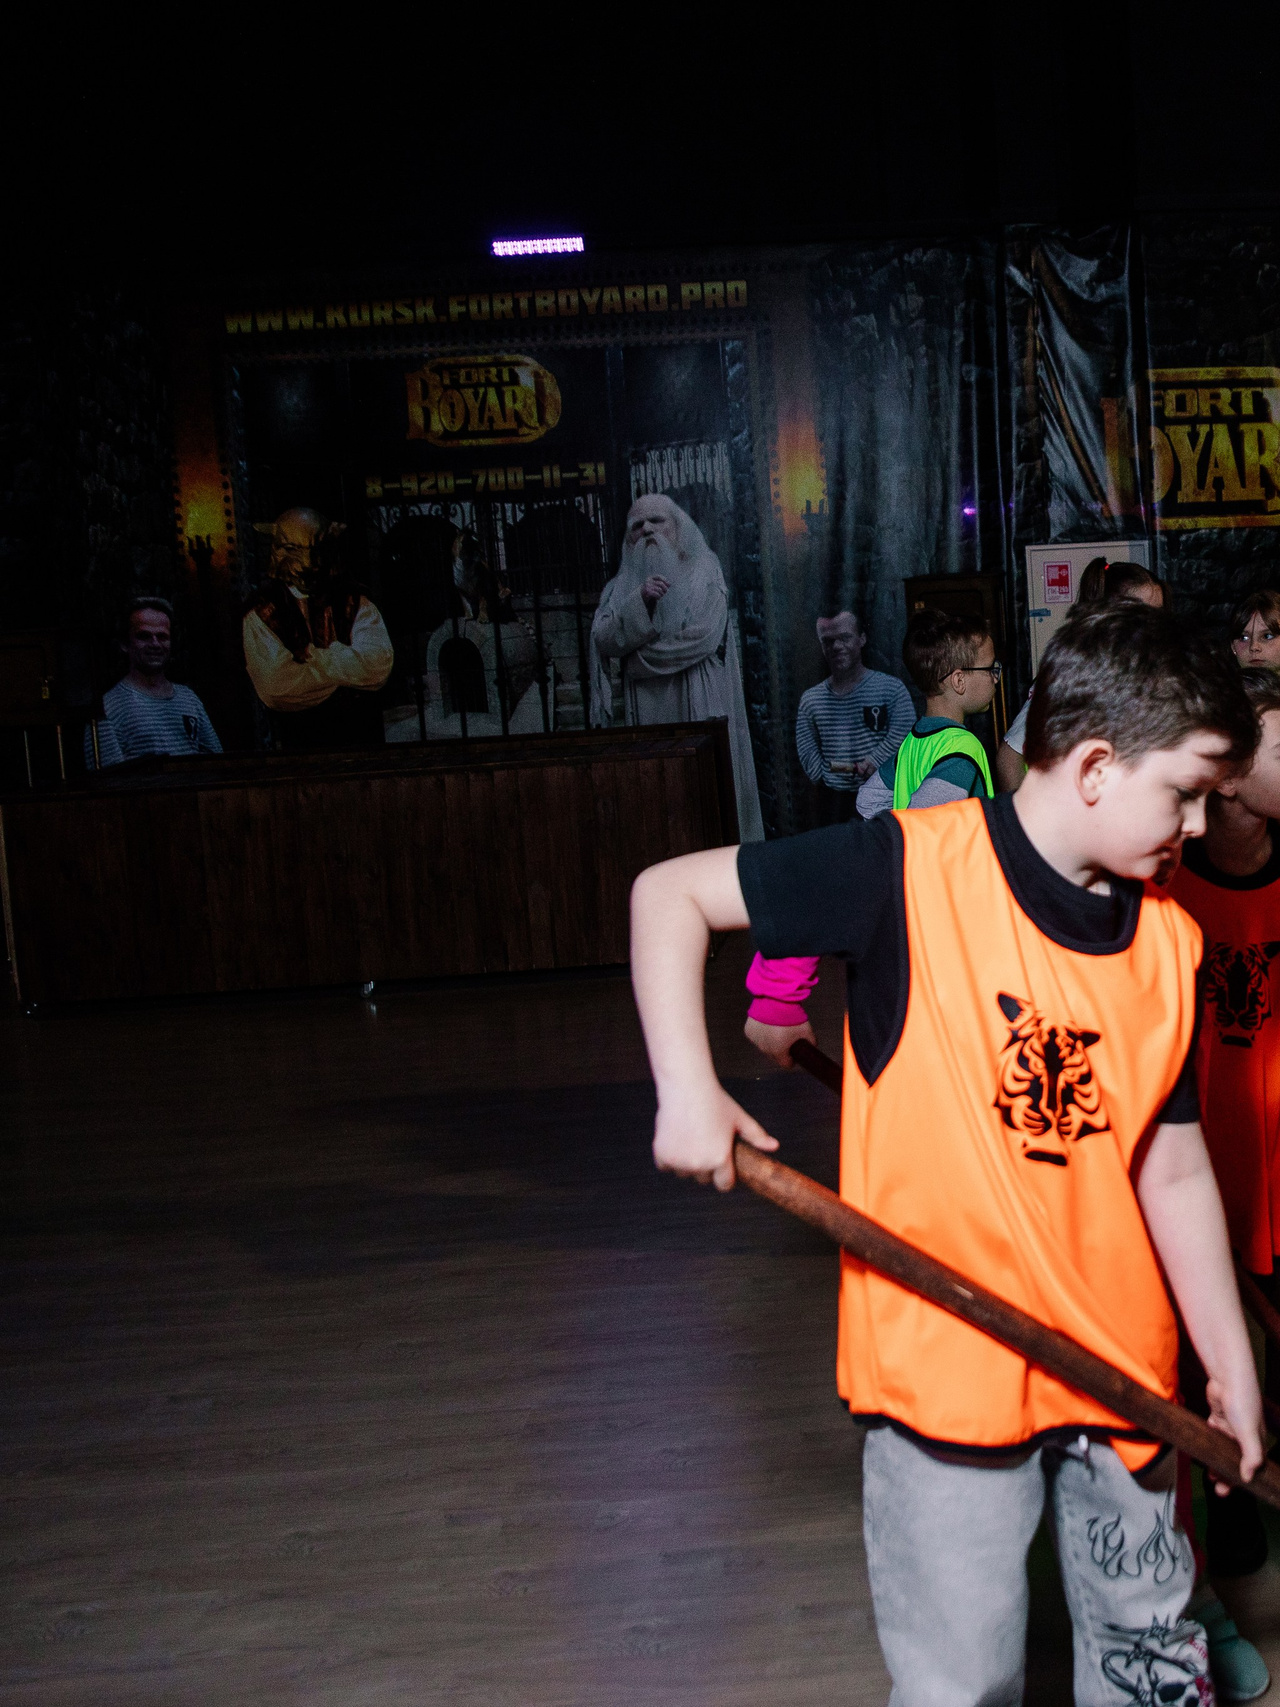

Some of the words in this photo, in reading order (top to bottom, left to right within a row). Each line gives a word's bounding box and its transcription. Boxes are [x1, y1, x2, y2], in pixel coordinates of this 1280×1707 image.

[224, 280, 748, 334] WWW.KURSK.FORTBOYARD.PRO
[442, 366, 515, 385] FORT
[404, 373, 562, 440] BOYARD
[365, 462, 606, 498] 8-920-700-11-31
